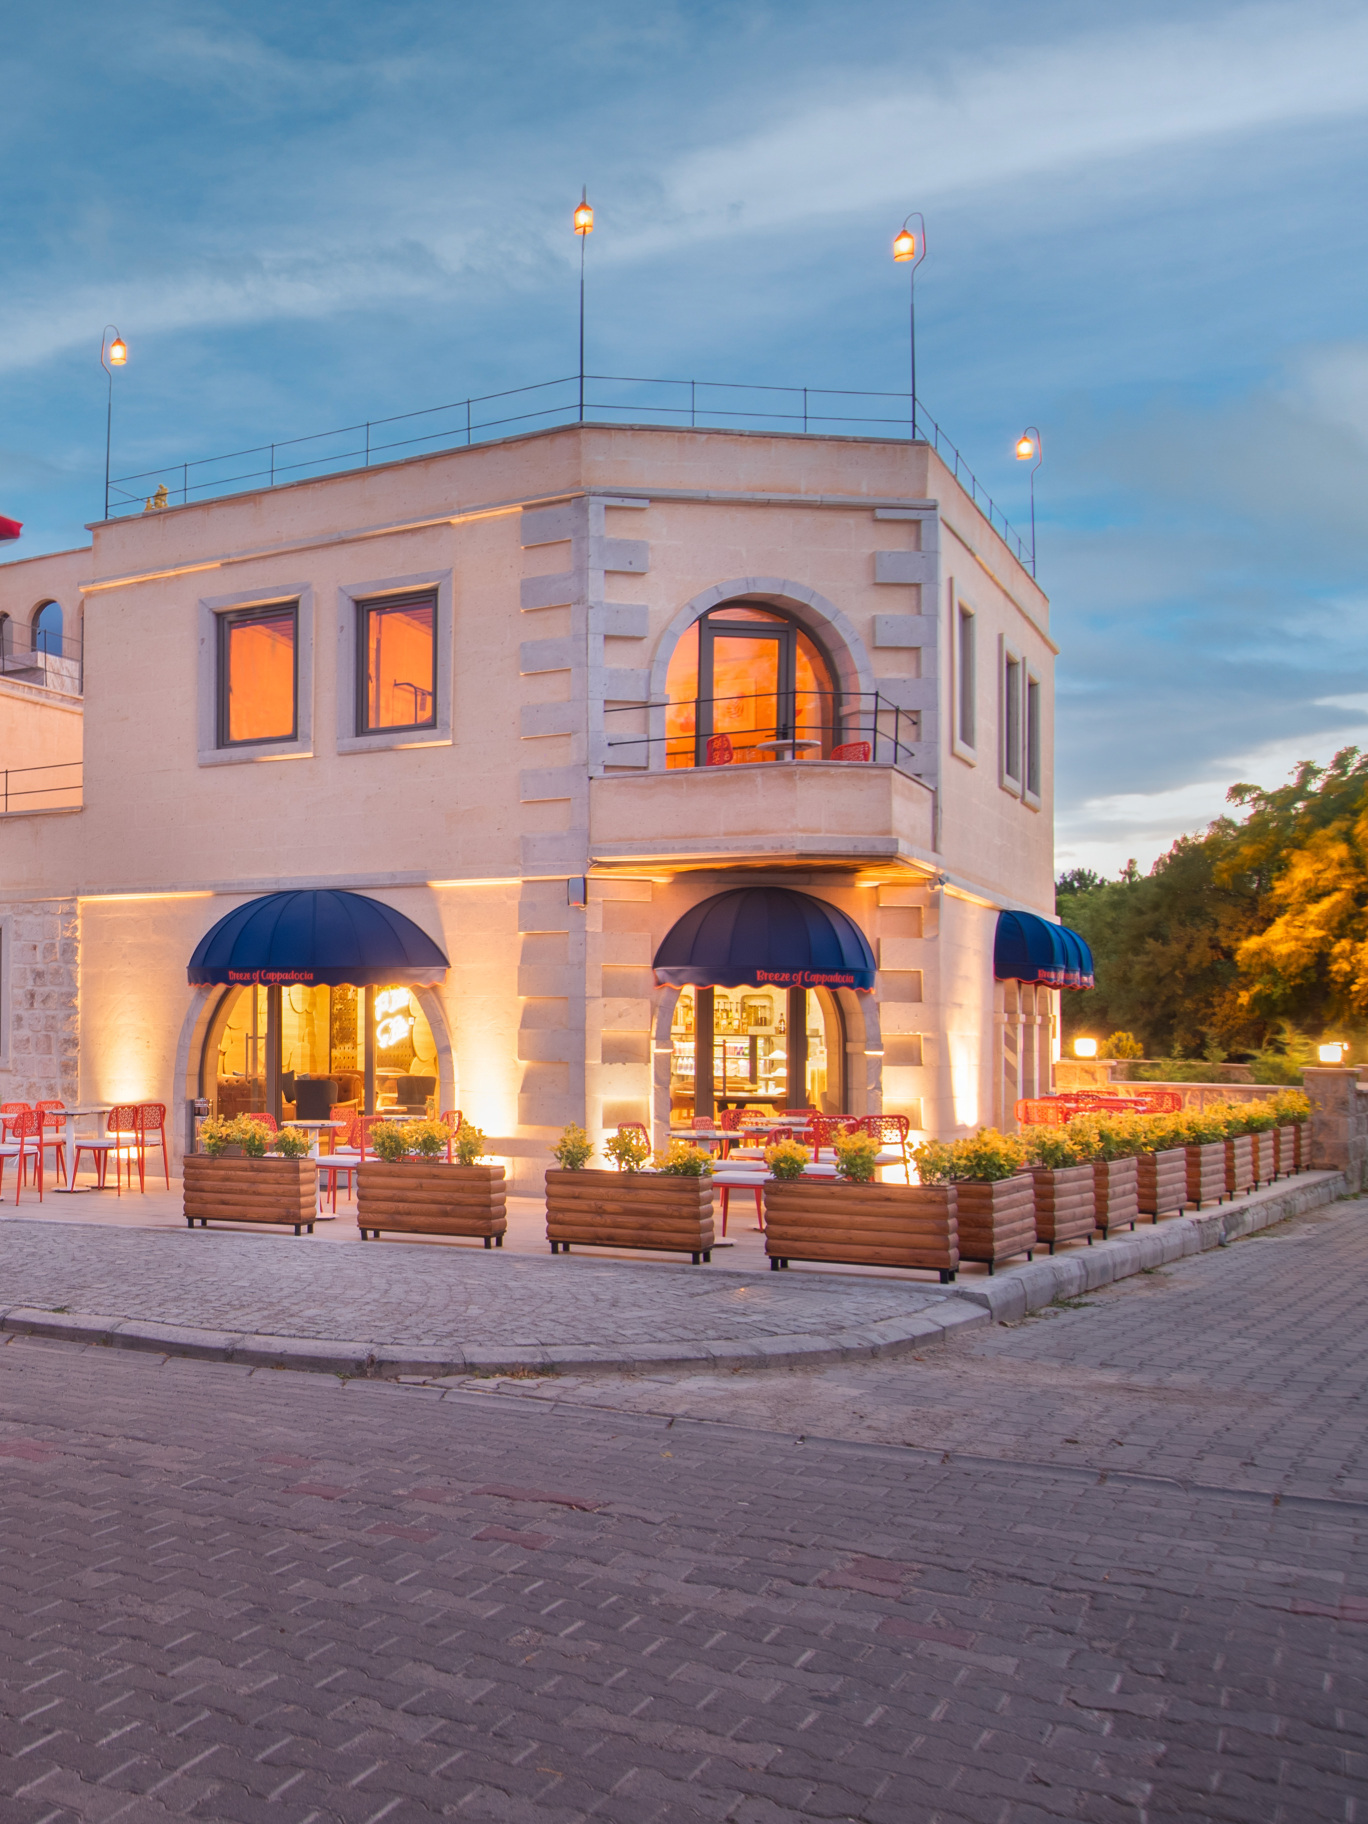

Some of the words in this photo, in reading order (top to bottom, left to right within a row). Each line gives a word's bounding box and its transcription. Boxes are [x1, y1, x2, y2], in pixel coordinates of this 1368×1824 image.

[228, 970, 251, 980] Breeze
[252, 970, 260, 983] of
[261, 970, 314, 982] Cappadocia
[756, 970, 791, 981] Breeze
[792, 970, 803, 985] of
[804, 971, 854, 984] Cappadocia
